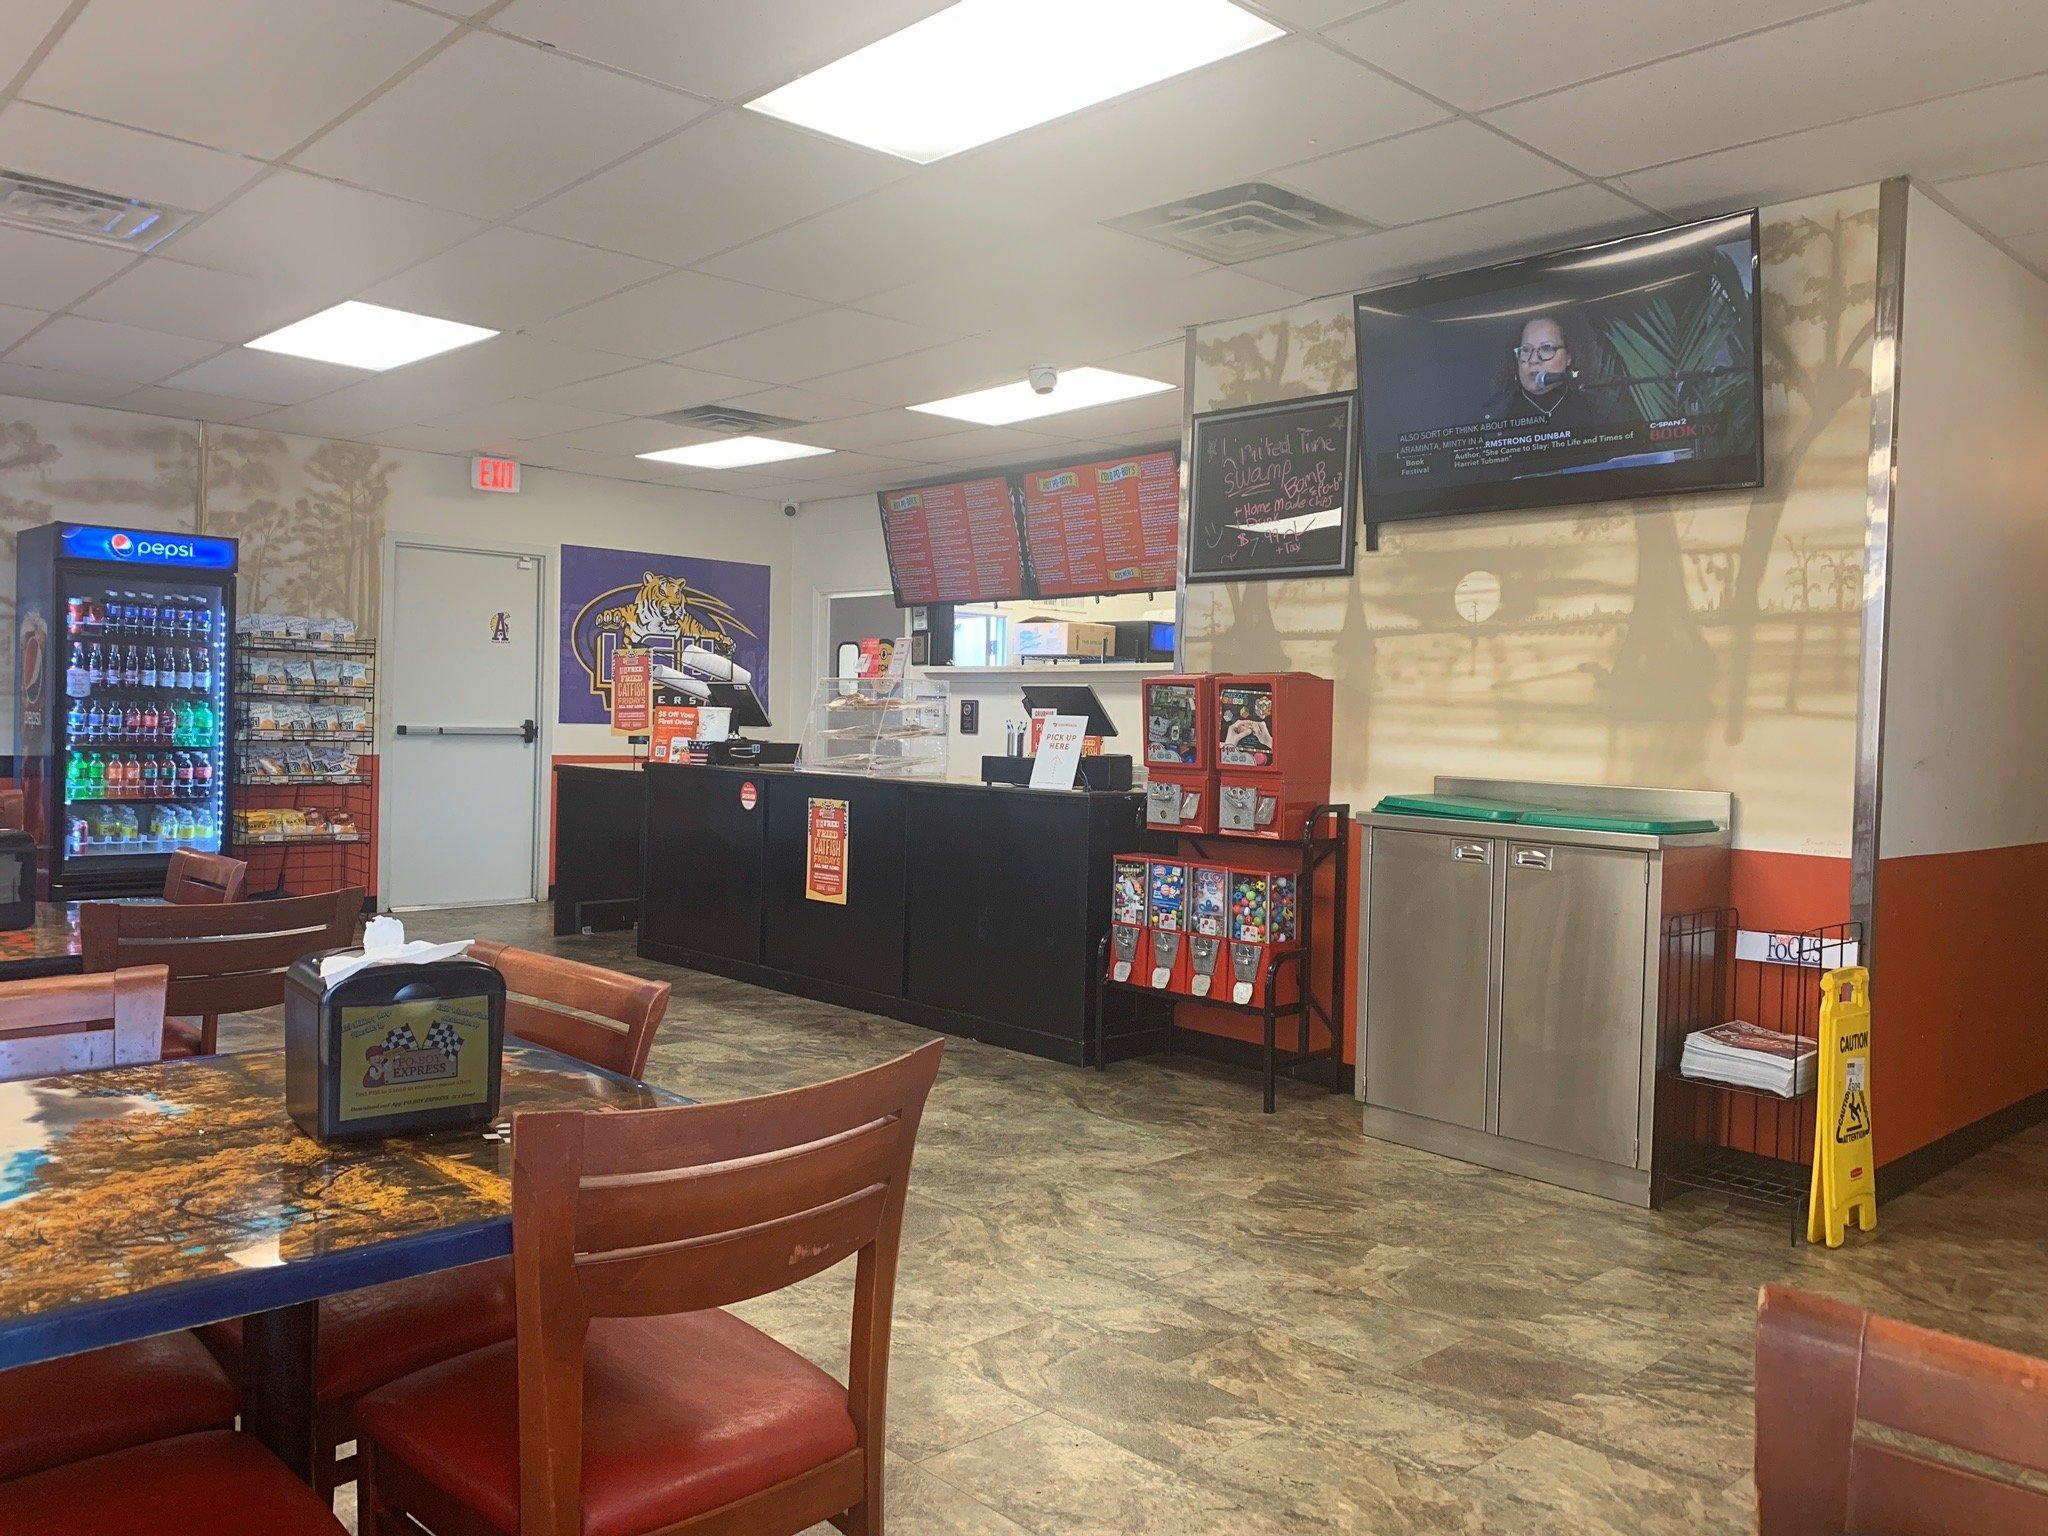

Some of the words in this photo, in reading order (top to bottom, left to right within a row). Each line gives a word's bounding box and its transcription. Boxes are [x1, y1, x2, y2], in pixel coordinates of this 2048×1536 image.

[1400, 433, 1420, 444] ALSO
[1420, 431, 1441, 441] SORT
[1442, 429, 1453, 438] OF
[1455, 425, 1479, 436] THINK
[1480, 421, 1508, 432] ABOUT
[1509, 415, 1548, 427] TUBMAN,
[1650, 427, 1697, 442] BOOK
[1297, 427, 1336, 454] Time
[1401, 443, 1441, 454] ARAMINTA,
[1442, 440, 1467, 450] MINTY
[1468, 437, 1477, 446] IN
[1454, 451, 1482, 461] Author,
[1500, 446, 1521, 456] Came
[1522, 444, 1531, 452] to
[1551, 440, 1566, 448] The
[1567, 437, 1581, 447] Life
[1582, 435, 1598, 444] and
[1599, 433, 1624, 443] Times
[1624, 431, 1634, 440] of
[1484, 435, 1532, 448] RMSTRONG
[1534, 431, 1571, 442] DUNBAR
[1405, 459, 1425, 467] Book
[1454, 459, 1479, 469] Harriet
[479, 458, 514, 489] EXIT
[1401, 467, 1430, 476] Festival
[1243, 501, 1271, 518] Home
[137, 541, 195, 559] pepsi
[618, 682, 646, 697] CATFISH
[680, 711, 696, 719] Your
[1047, 733, 1065, 741] PICK
[1049, 742, 1070, 750] HERE
[813, 837, 841, 857] CATFISH
[1839, 1031, 1869, 1053] CAUTION
[393, 1063, 446, 1078] EXPRESS
[1842, 1130, 1867, 1144] ATTENTION
